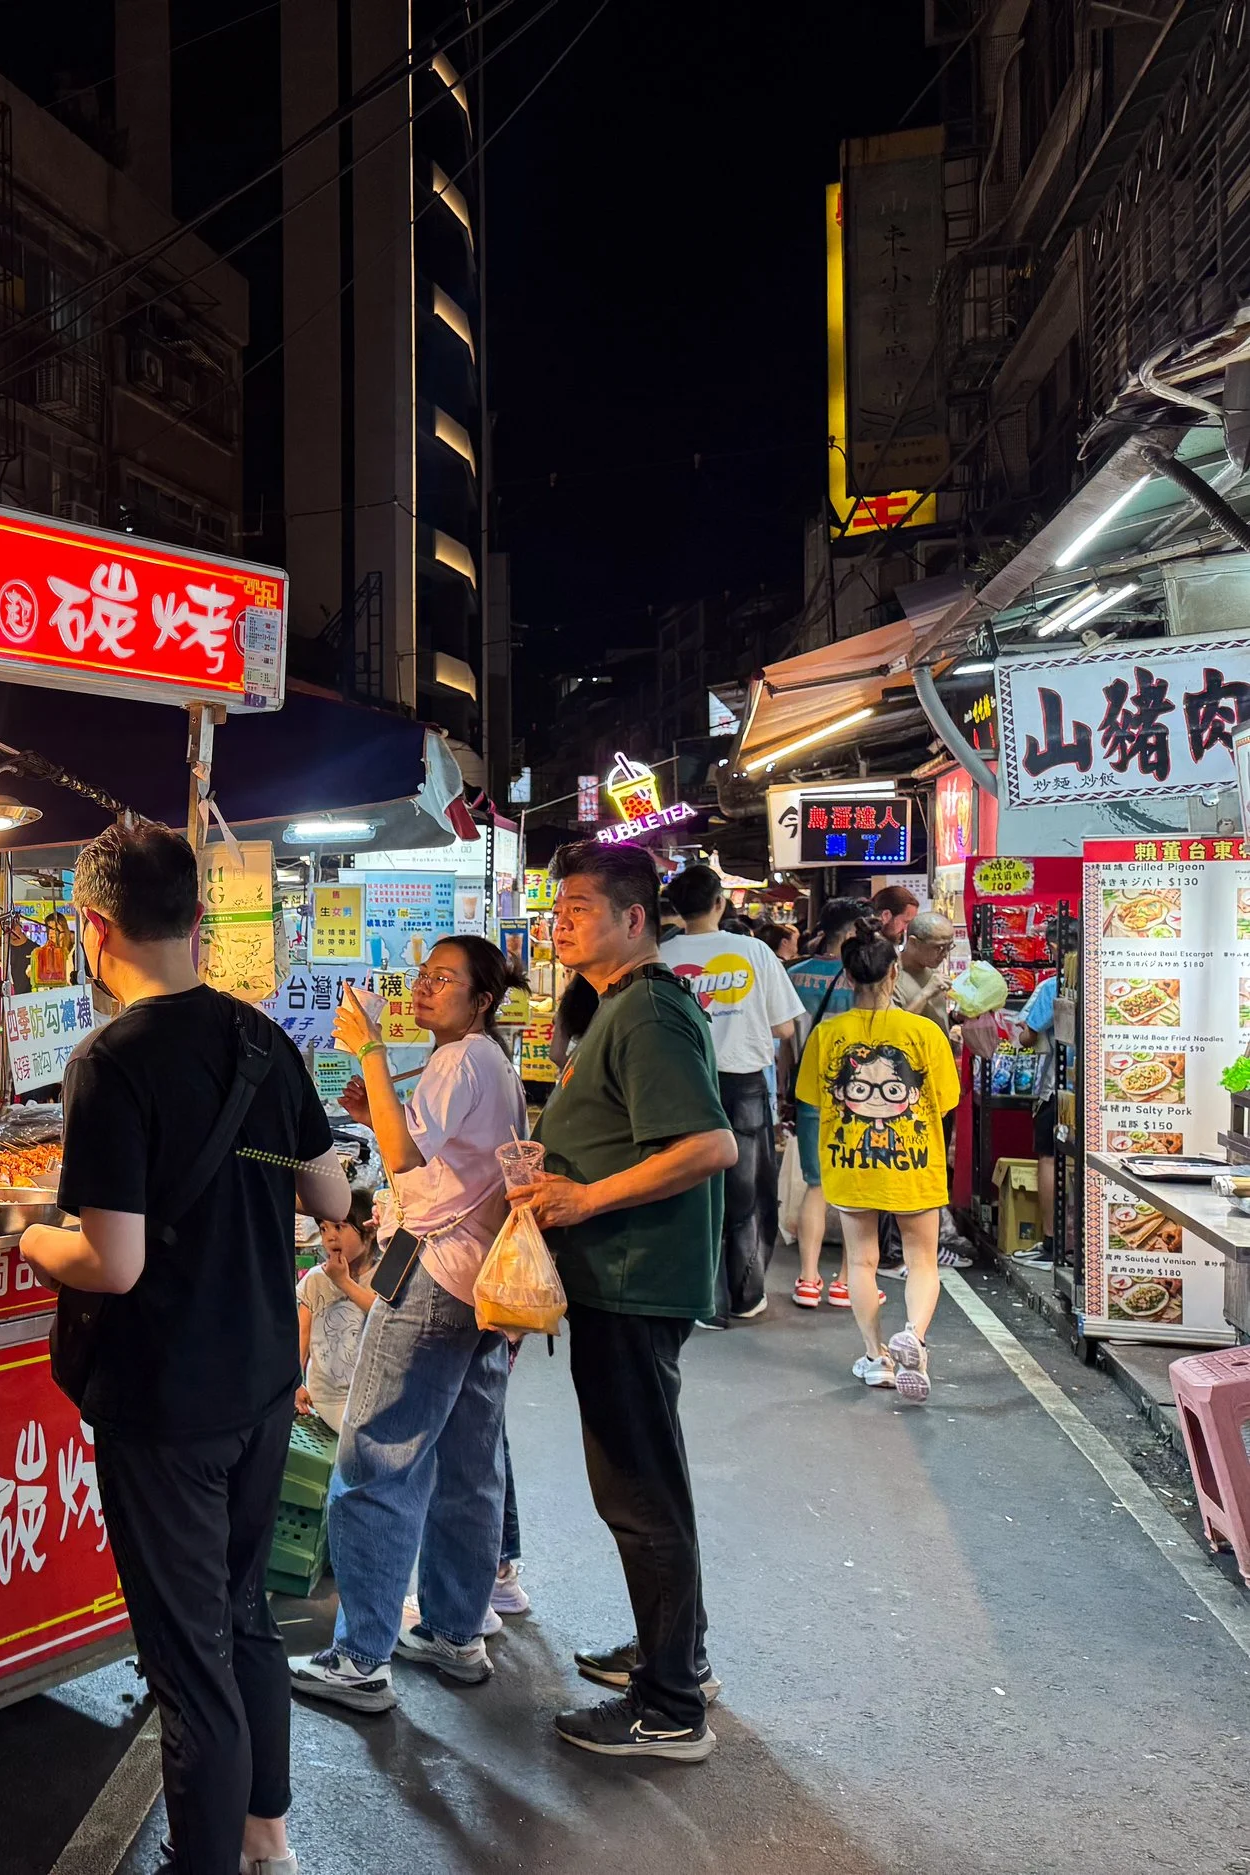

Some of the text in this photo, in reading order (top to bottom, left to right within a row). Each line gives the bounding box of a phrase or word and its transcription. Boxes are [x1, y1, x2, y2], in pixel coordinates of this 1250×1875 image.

[1022, 666, 1250, 783] 山豬肉
[597, 802, 698, 844] BUBBLE TEA
[1128, 863, 1163, 872] Grilled
[1168, 864, 1205, 873] Pigeon
[992, 883, 1012, 891] 100
[1169, 878, 1199, 887] $130
[389, 1022, 420, 1038] 送一
[1193, 1034, 1224, 1042] Noodles
[1136, 1105, 1163, 1117] Salty
[1167, 1107, 1192, 1116] Pork
[1144, 1121, 1173, 1130] $150
[1163, 1257, 1197, 1266] Venison
[1158, 1268, 1181, 1277] $180
